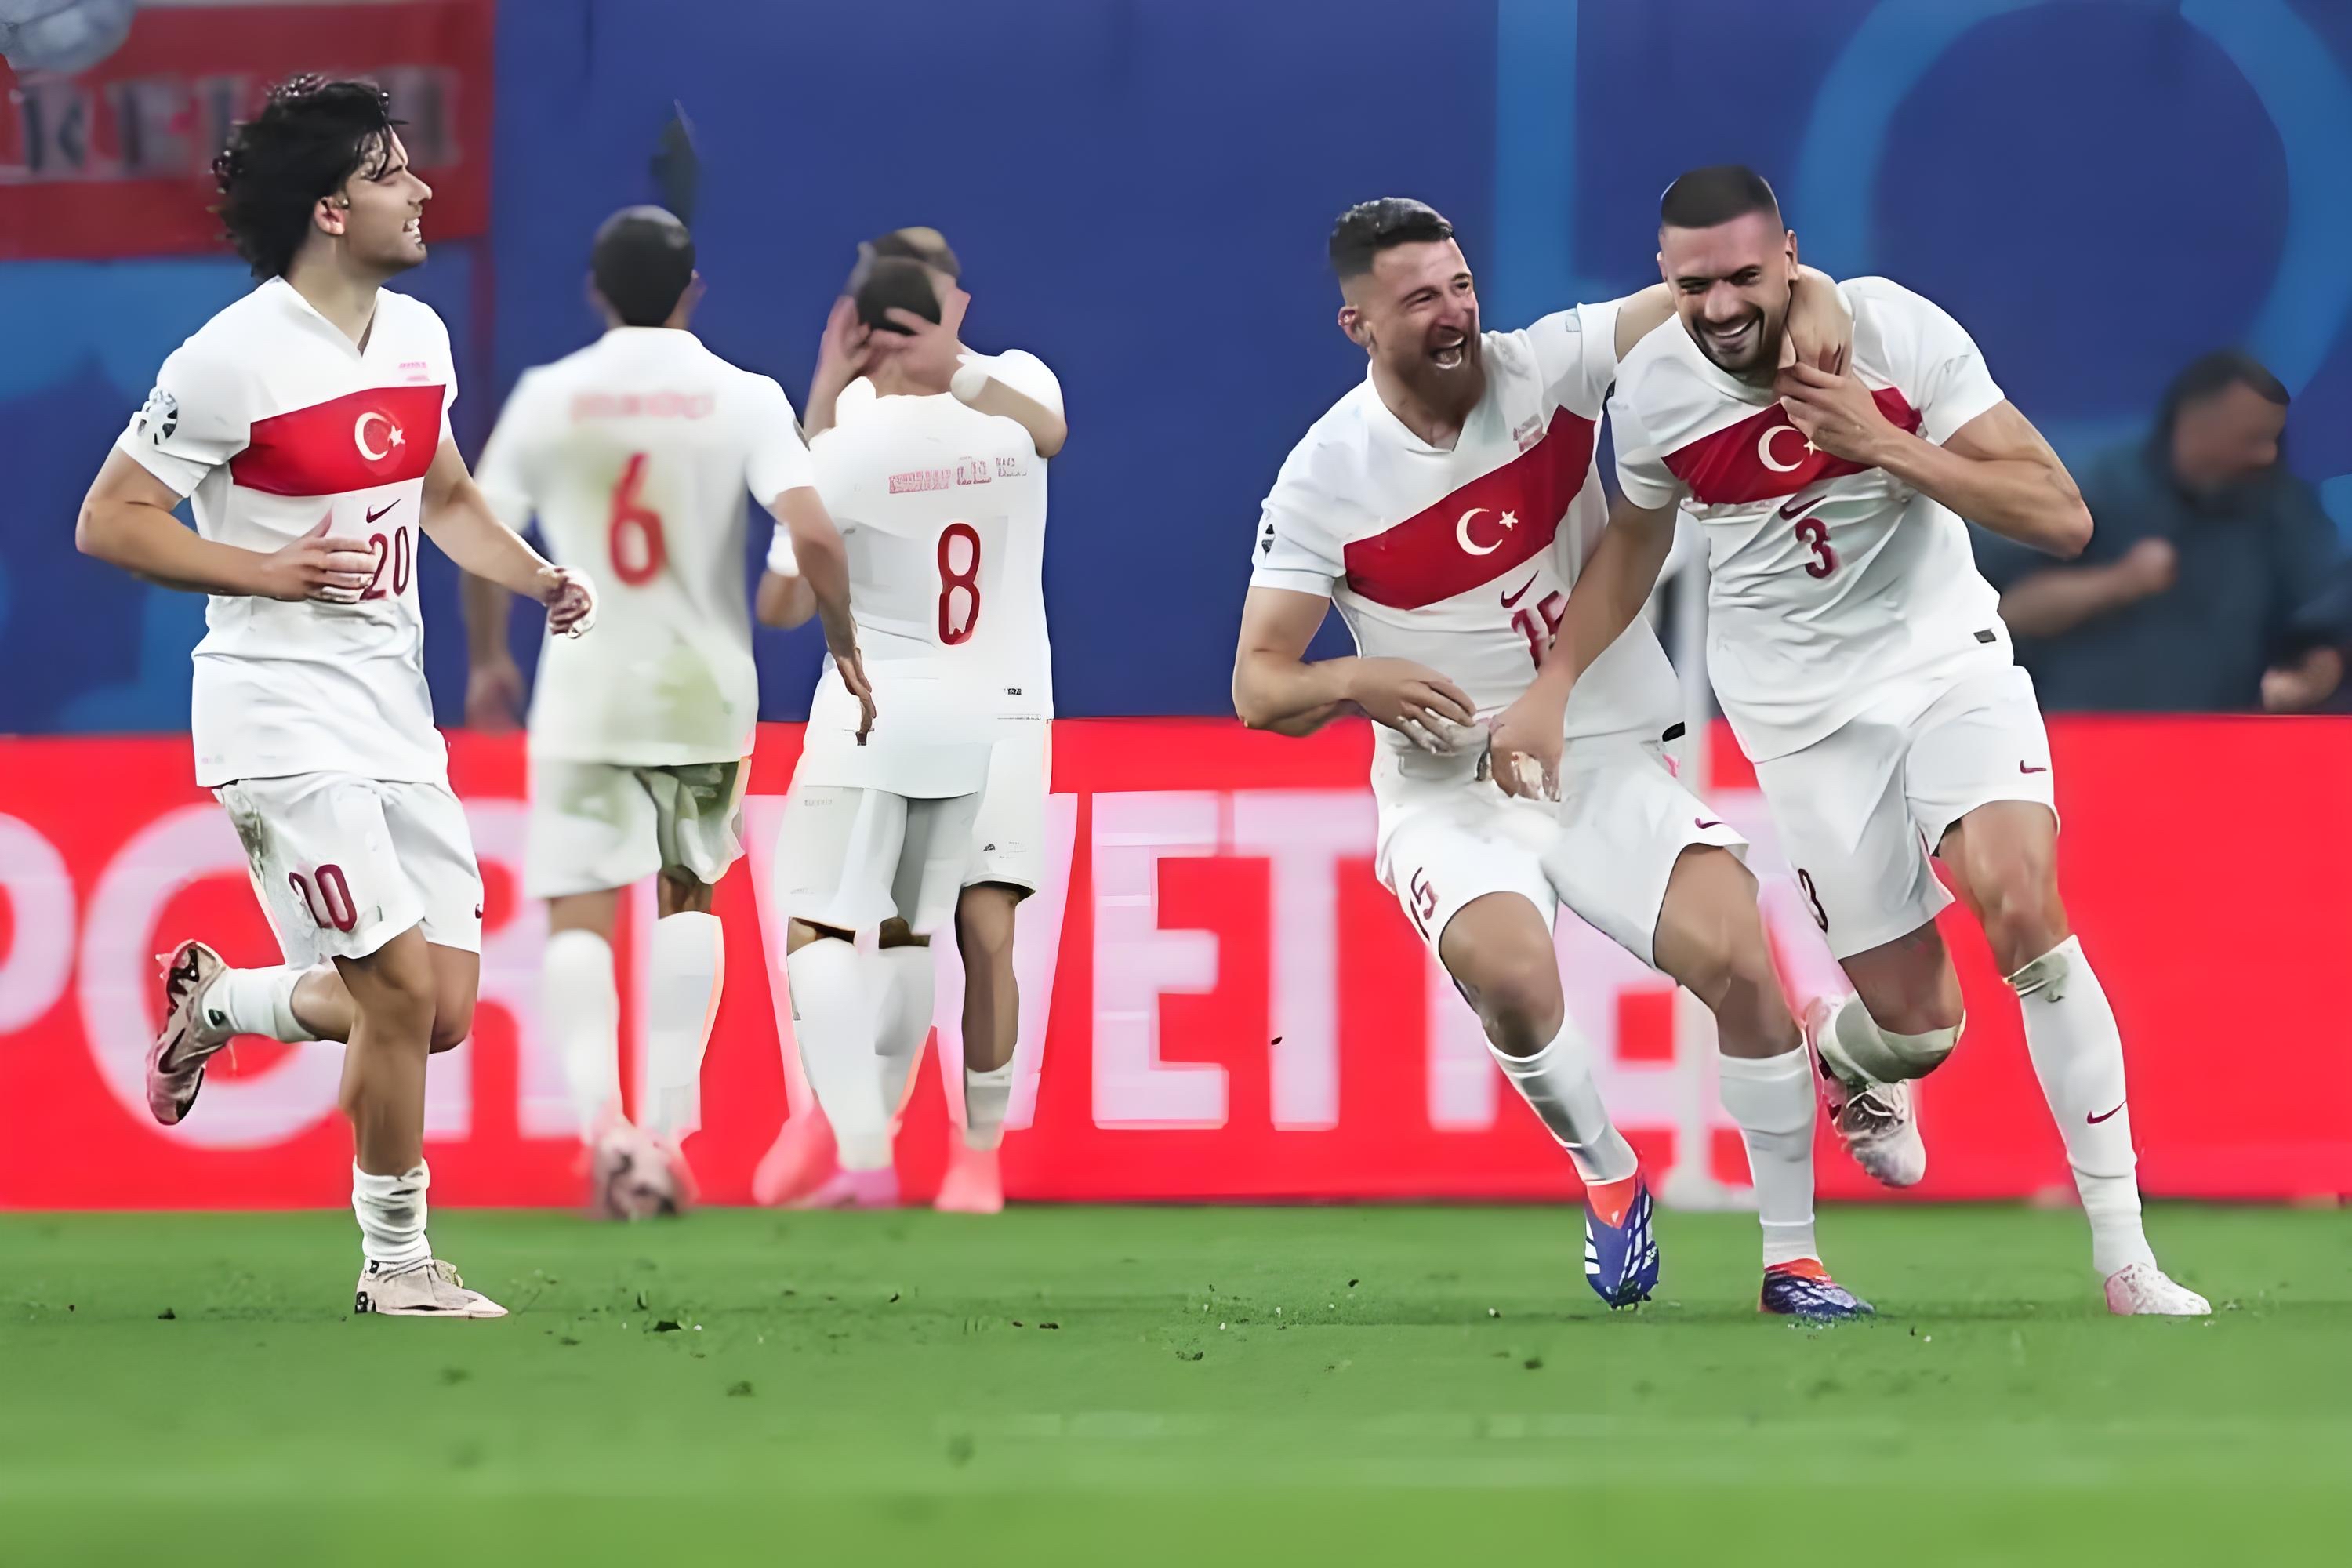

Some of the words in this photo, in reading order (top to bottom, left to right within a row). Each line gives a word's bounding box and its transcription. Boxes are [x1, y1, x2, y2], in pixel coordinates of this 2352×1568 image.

[359, 525, 410, 601] 20
[607, 451, 667, 588] 6
[1795, 517, 1838, 579] 3
[937, 522, 981, 645] 8
